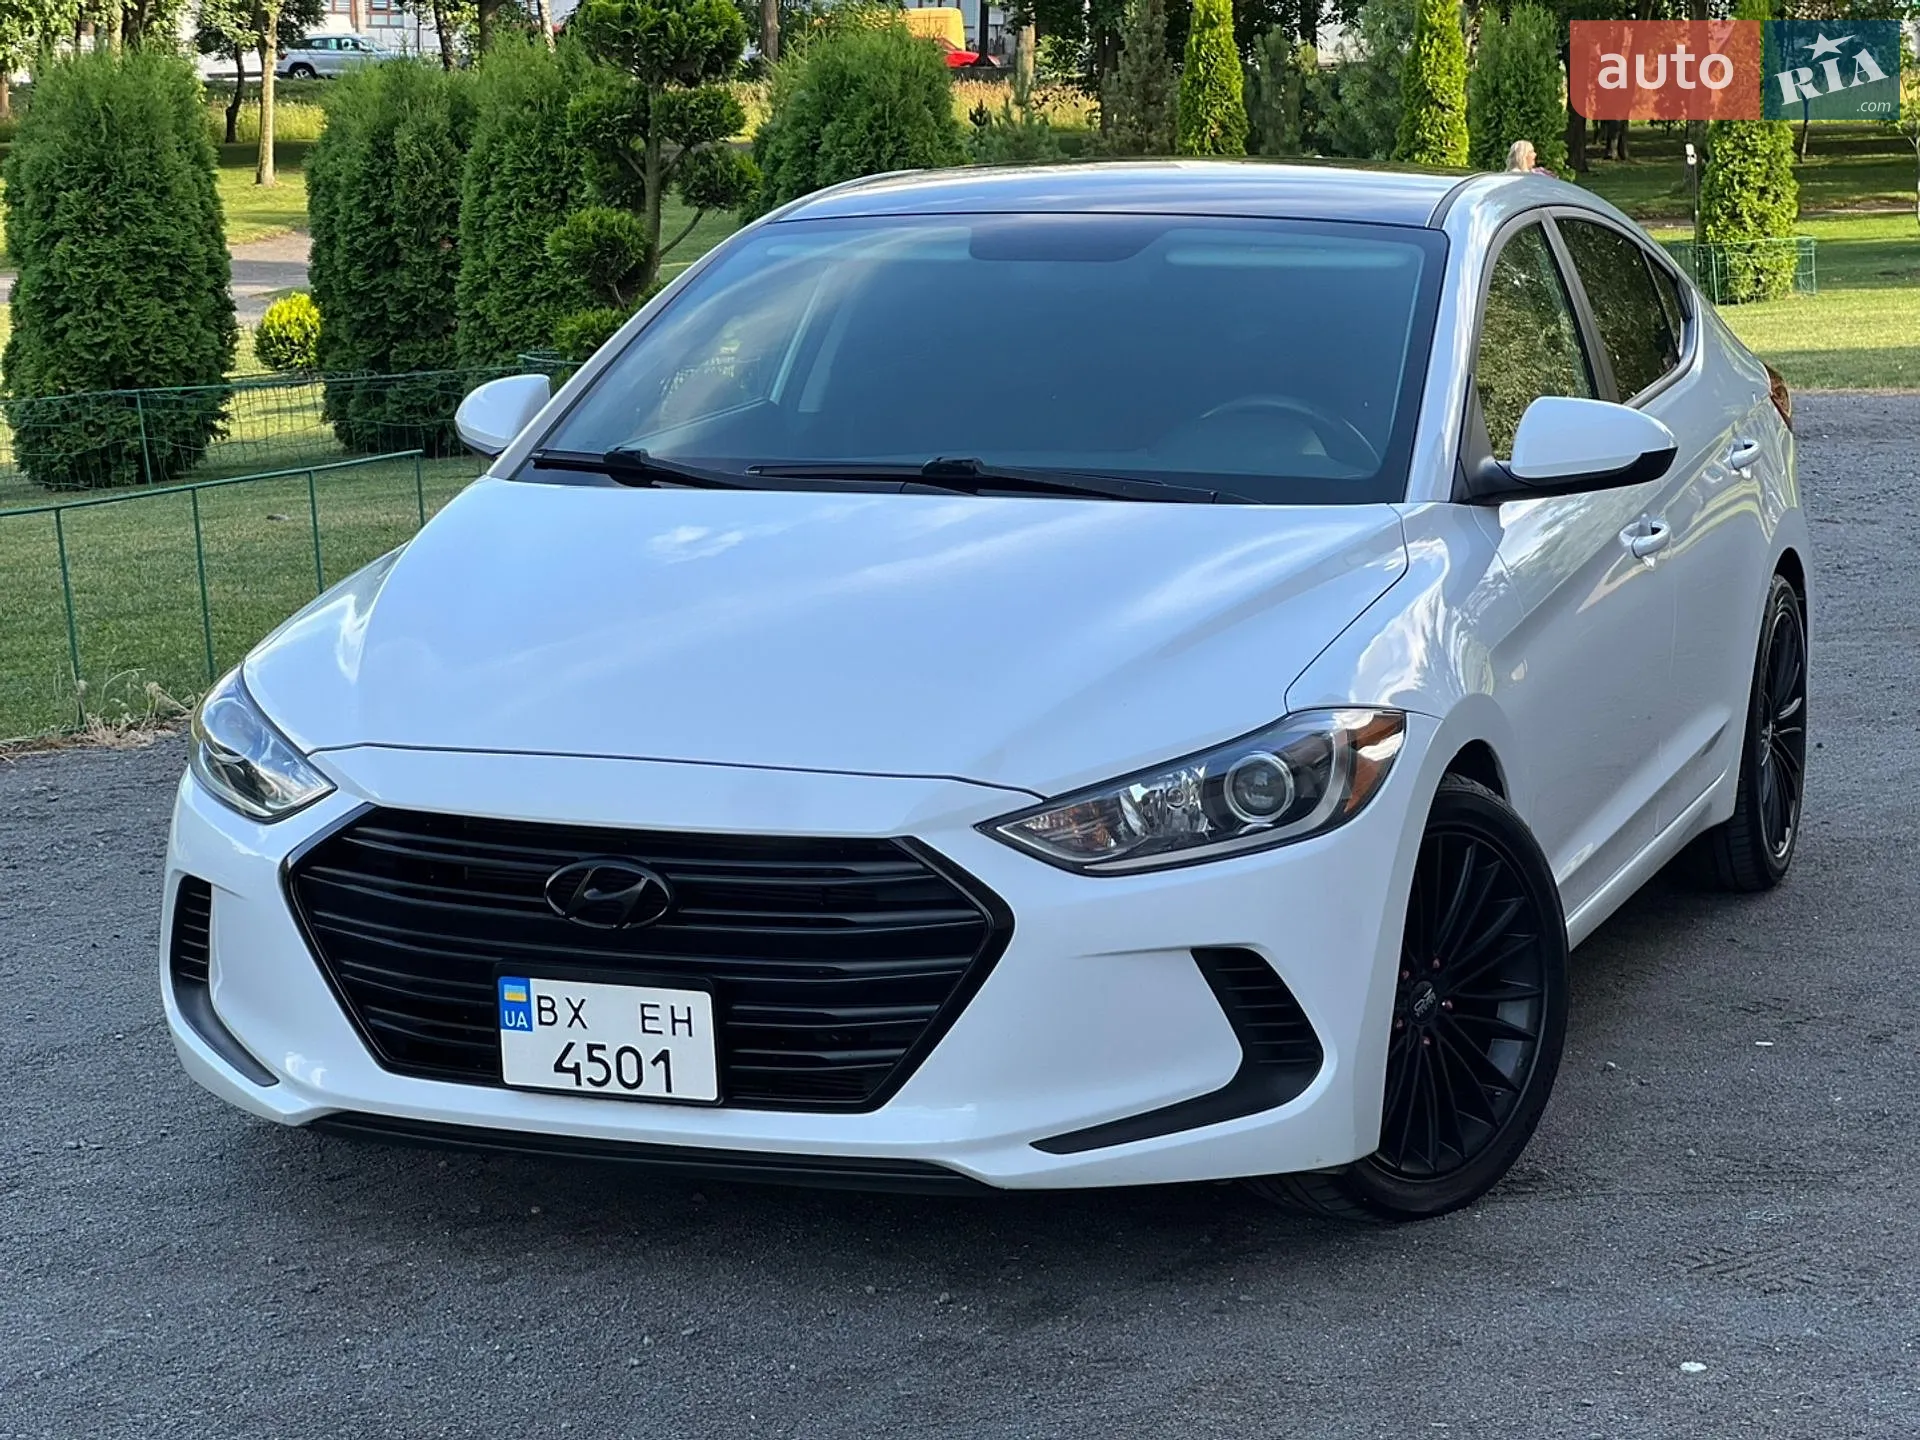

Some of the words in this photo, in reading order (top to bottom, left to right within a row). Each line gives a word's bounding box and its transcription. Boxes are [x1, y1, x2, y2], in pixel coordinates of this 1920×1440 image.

[504, 1010, 528, 1029] UA
[536, 995, 588, 1030] BX
[640, 1002, 693, 1037] EH
[553, 1041, 673, 1094] 4501
